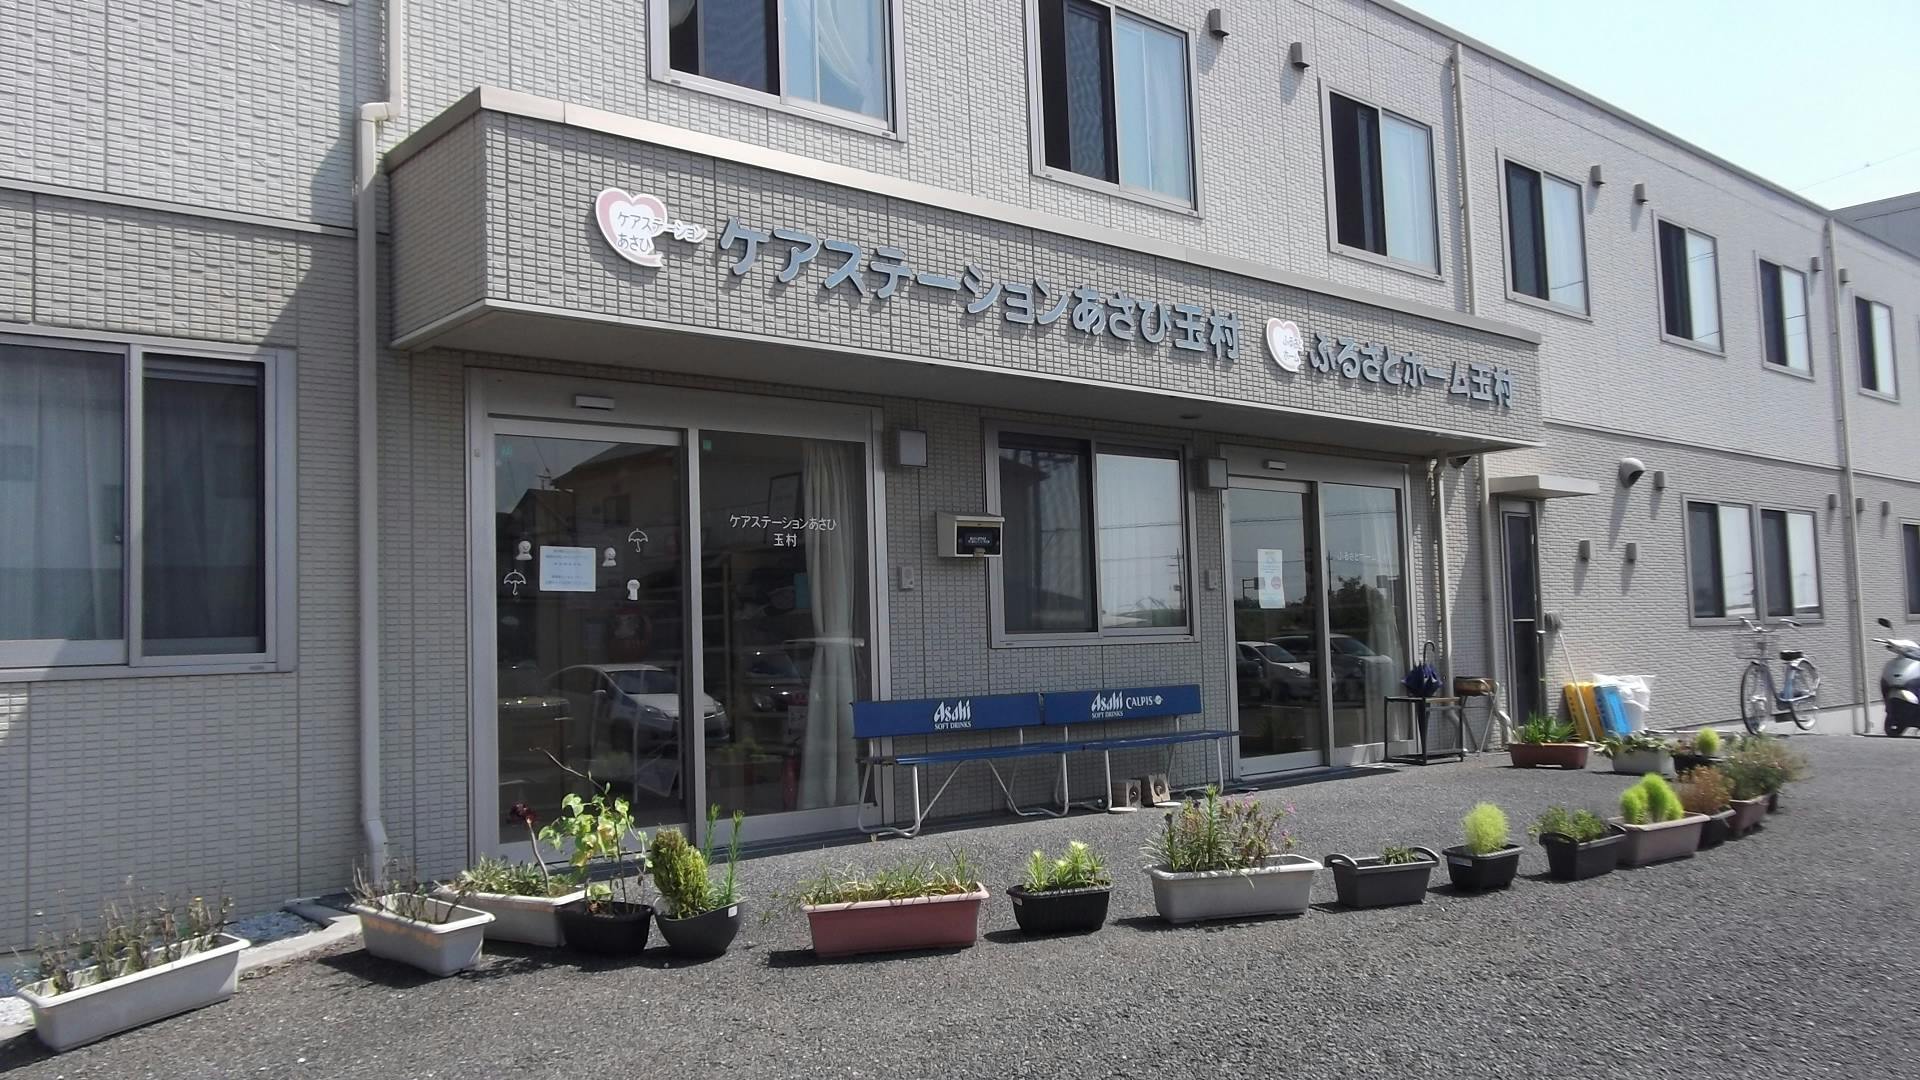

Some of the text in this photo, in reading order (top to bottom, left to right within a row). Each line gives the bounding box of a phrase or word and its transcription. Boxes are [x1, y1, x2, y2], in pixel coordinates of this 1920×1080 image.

[617, 211, 706, 240] ケアステーション
[617, 233, 653, 252] あさひ
[719, 215, 1241, 360] ケアステーションあさひ玉村
[1308, 332, 1512, 409] ふるさとホーム玉村
[729, 514, 837, 531] ケアステーションあさひ
[773, 533, 798, 547] 玉村
[933, 699, 971, 722] Asahi
[1091, 690, 1154, 712] Asahi CALPIS
[934, 722, 949, 730] SOFT
